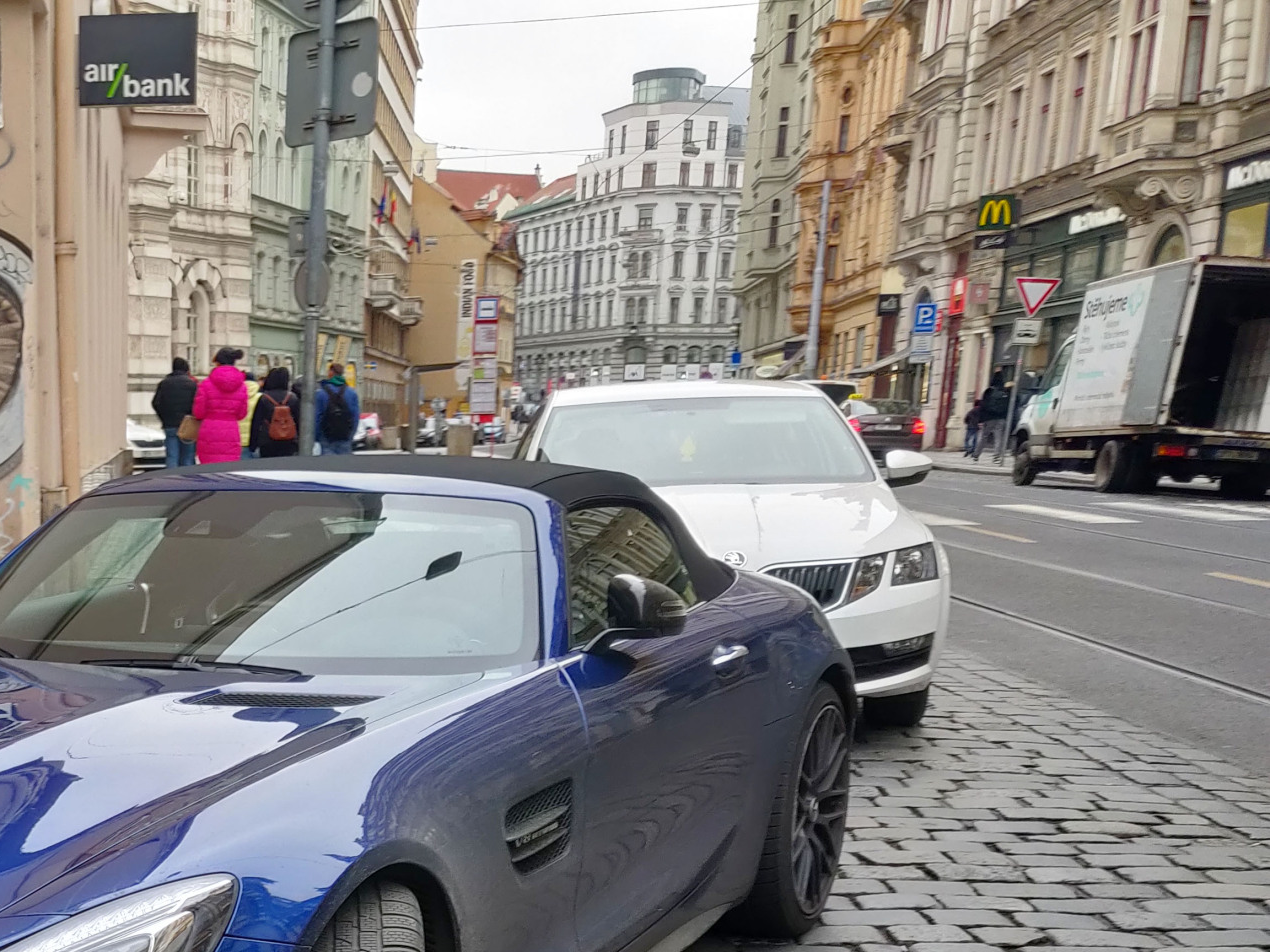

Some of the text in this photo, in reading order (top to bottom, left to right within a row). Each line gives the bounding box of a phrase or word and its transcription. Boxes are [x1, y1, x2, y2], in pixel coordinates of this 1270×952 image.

[123, 73, 191, 98] bank
[461, 287, 473, 318] INDIAN
[1084, 295, 1129, 321] Stěhujeme
